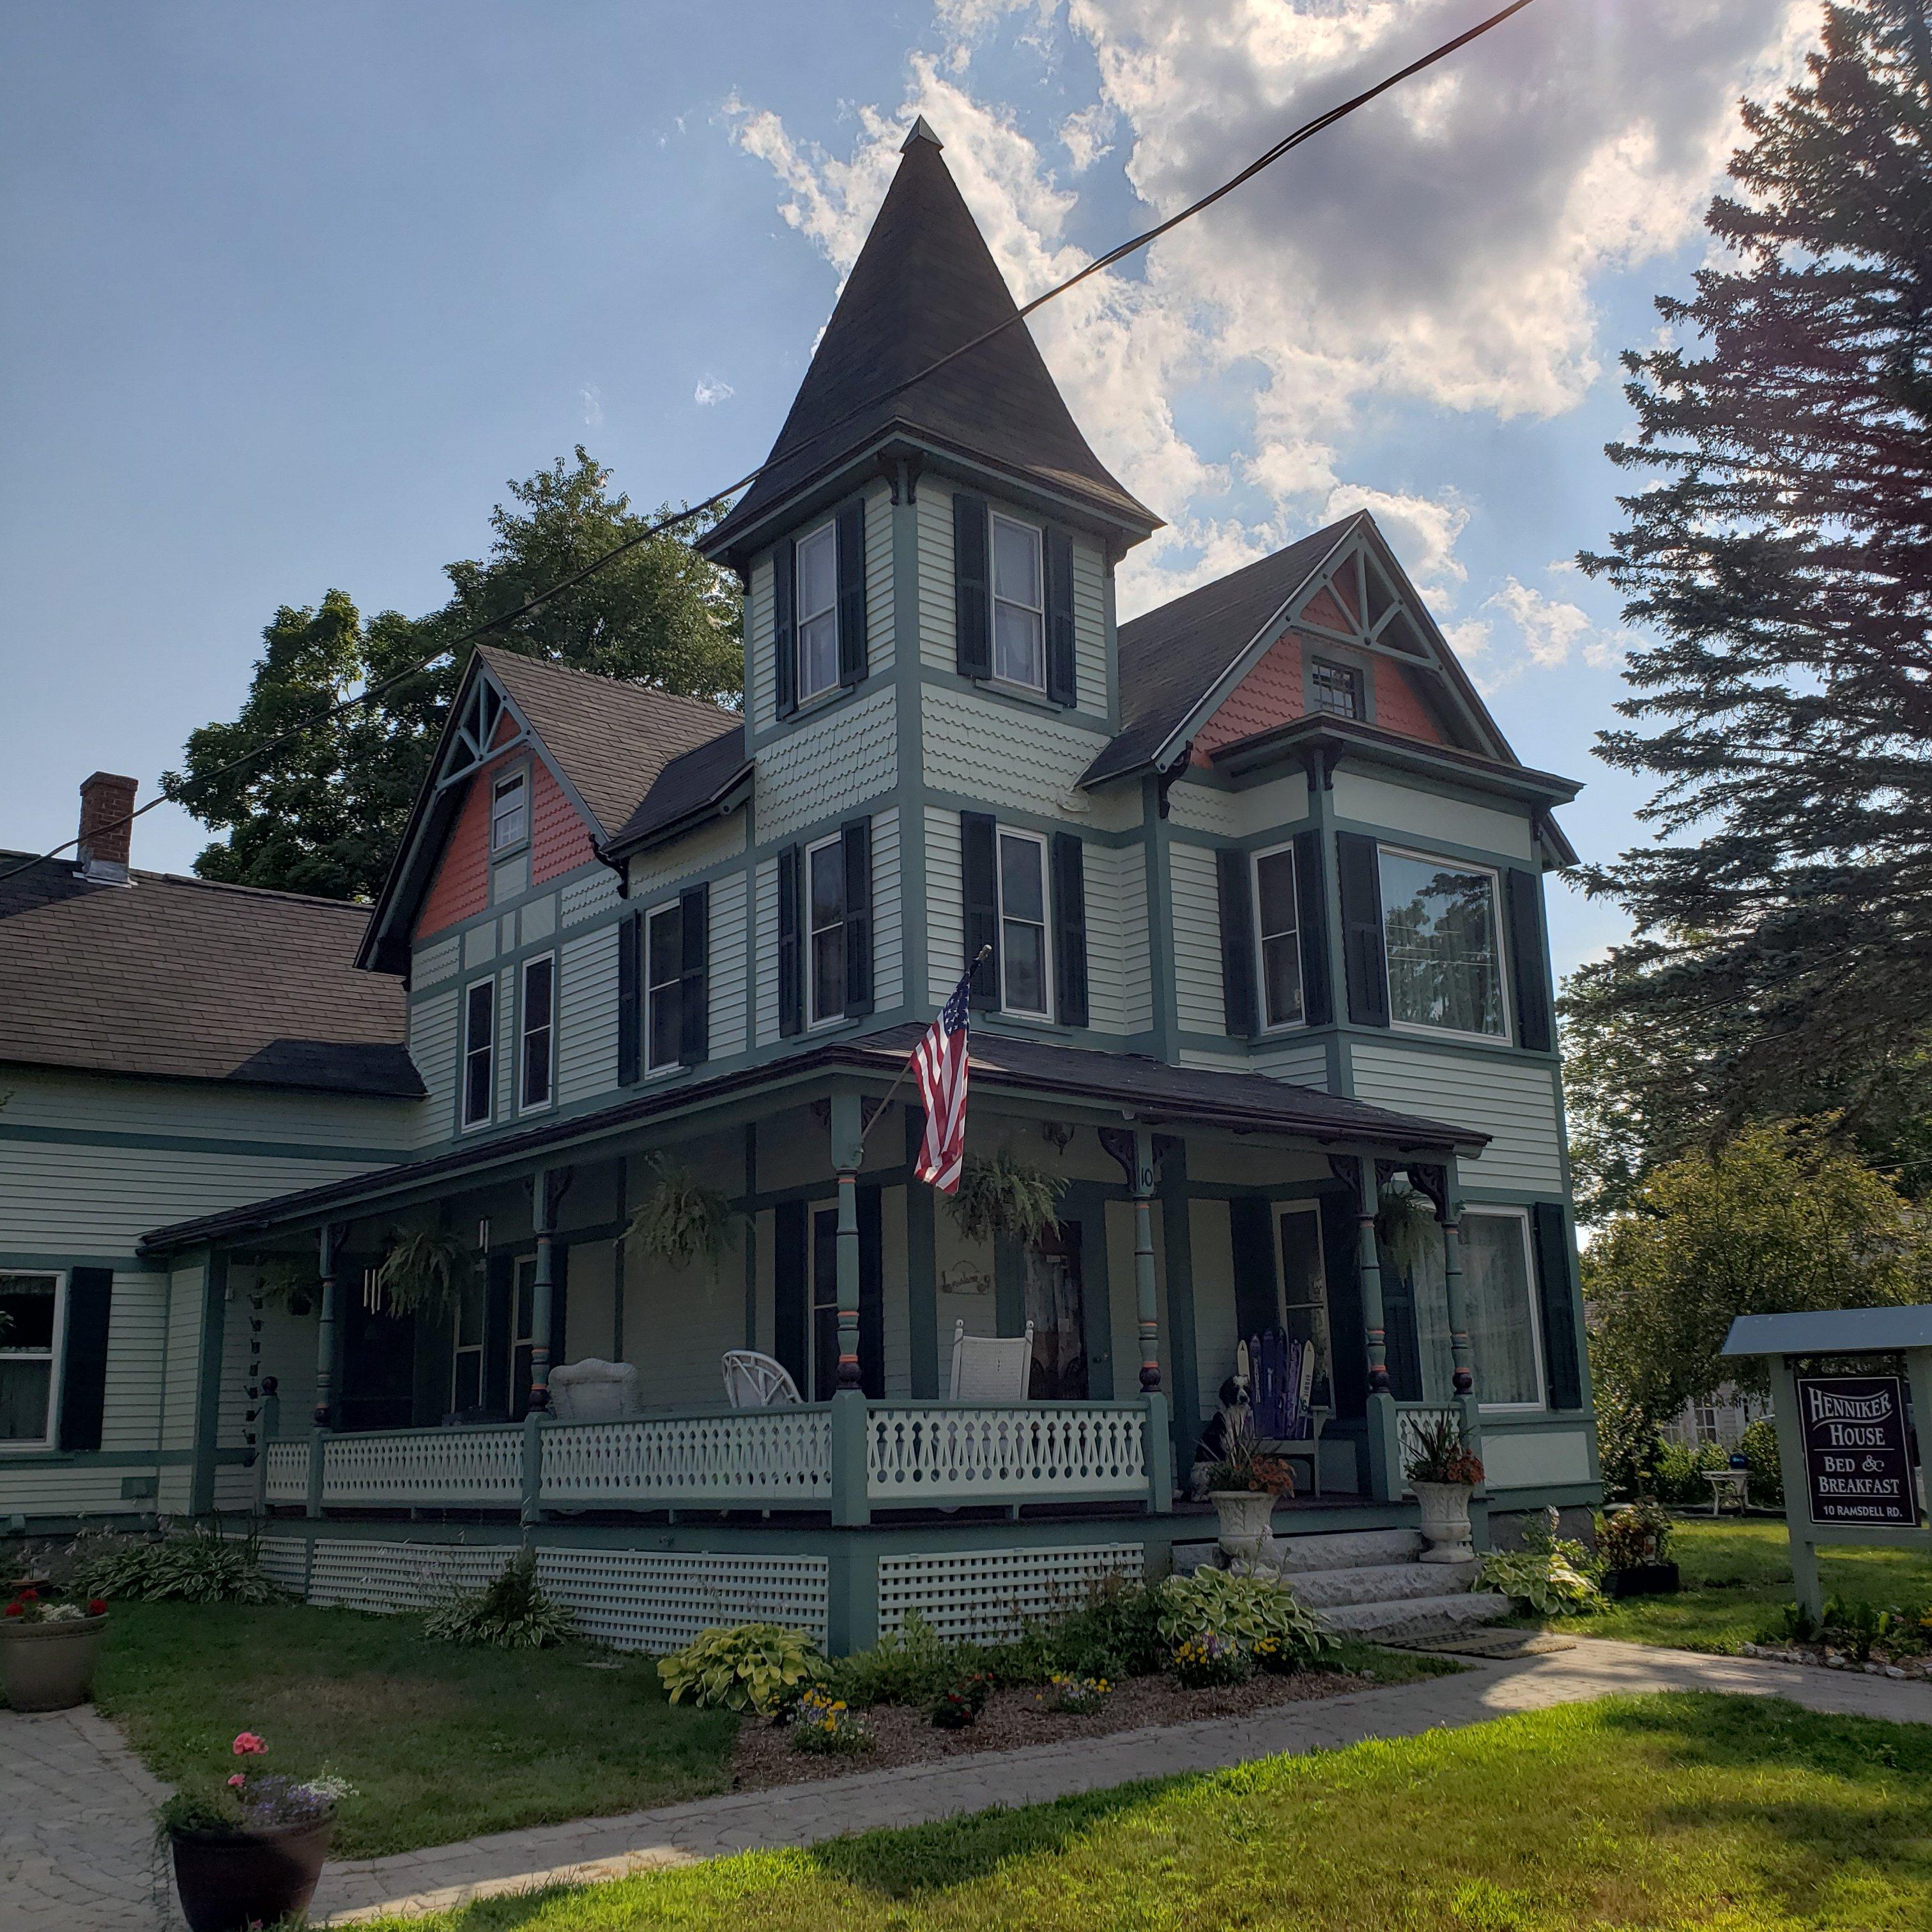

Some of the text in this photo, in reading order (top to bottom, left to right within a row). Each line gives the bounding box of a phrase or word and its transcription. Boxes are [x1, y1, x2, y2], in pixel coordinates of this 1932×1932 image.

[1141, 1167, 1153, 1186] 10
[1807, 1386, 1892, 1423] HENNIKER
[1829, 1424, 1886, 1446] HOUSE
[1823, 1455, 1885, 1473] BED &
[1818, 1476, 1900, 1494] BREAKFAST
[1823, 1505, 1903, 1517] 10 RAMSDELL RD.
